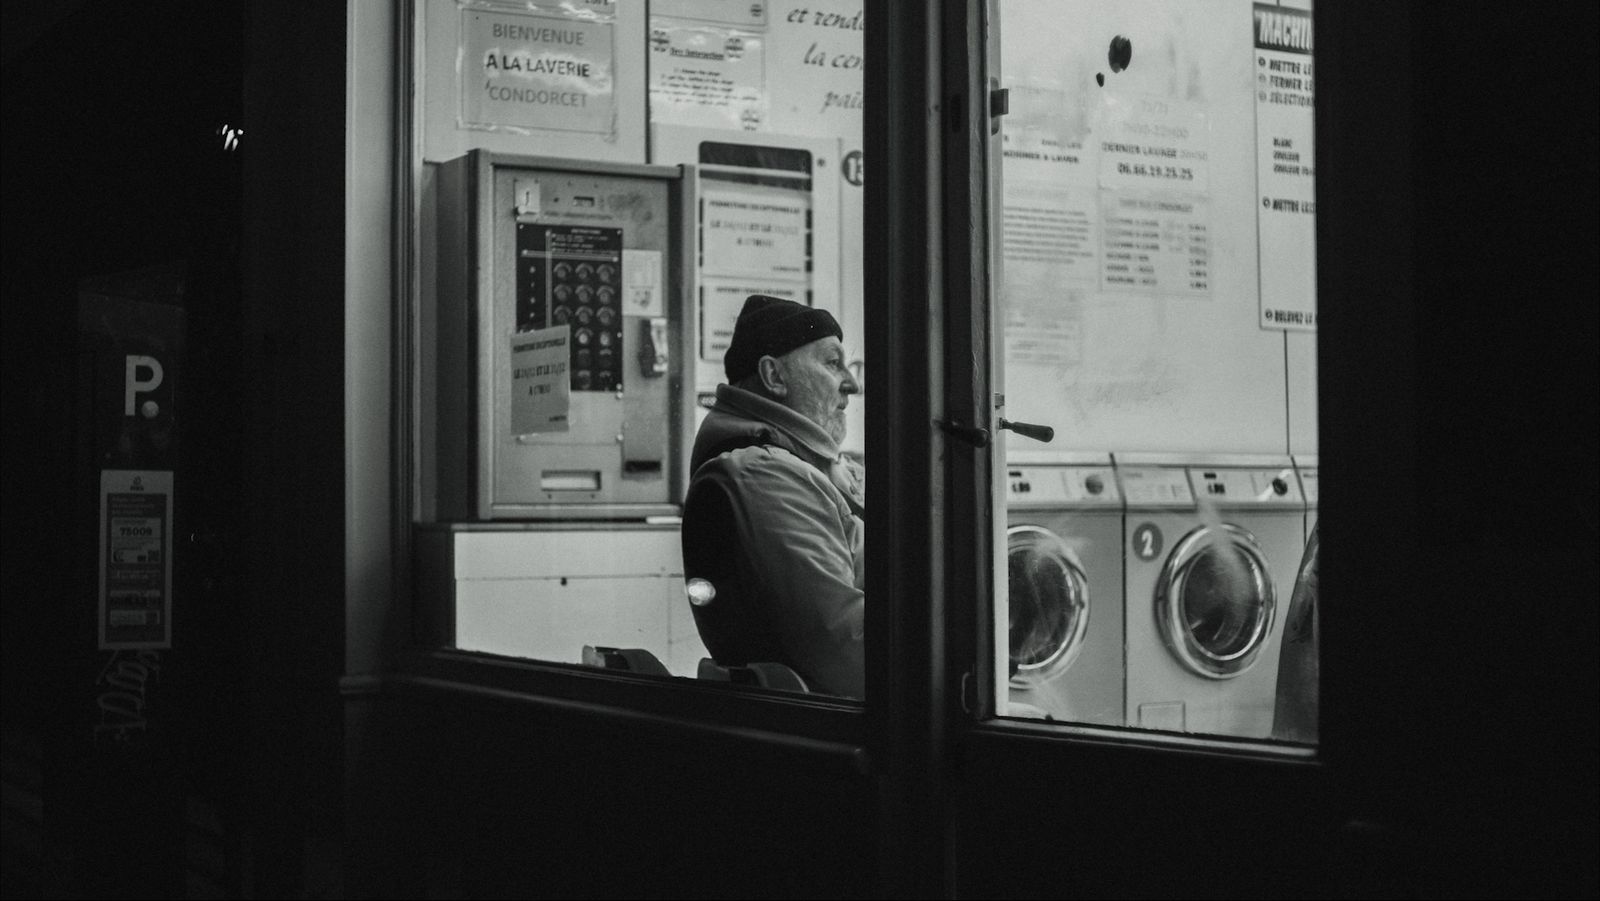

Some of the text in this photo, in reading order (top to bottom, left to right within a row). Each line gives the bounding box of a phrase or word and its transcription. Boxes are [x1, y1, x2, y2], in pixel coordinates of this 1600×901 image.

[787, 8, 863, 31] et rend
[493, 23, 584, 46] BIENVENUE
[486, 54, 591, 78] A LA LAVERIE
[804, 42, 825, 67] la
[1270, 59, 1301, 74] METTRE
[488, 85, 588, 108] CONDORCET
[1141, 529, 1154, 557] 2
